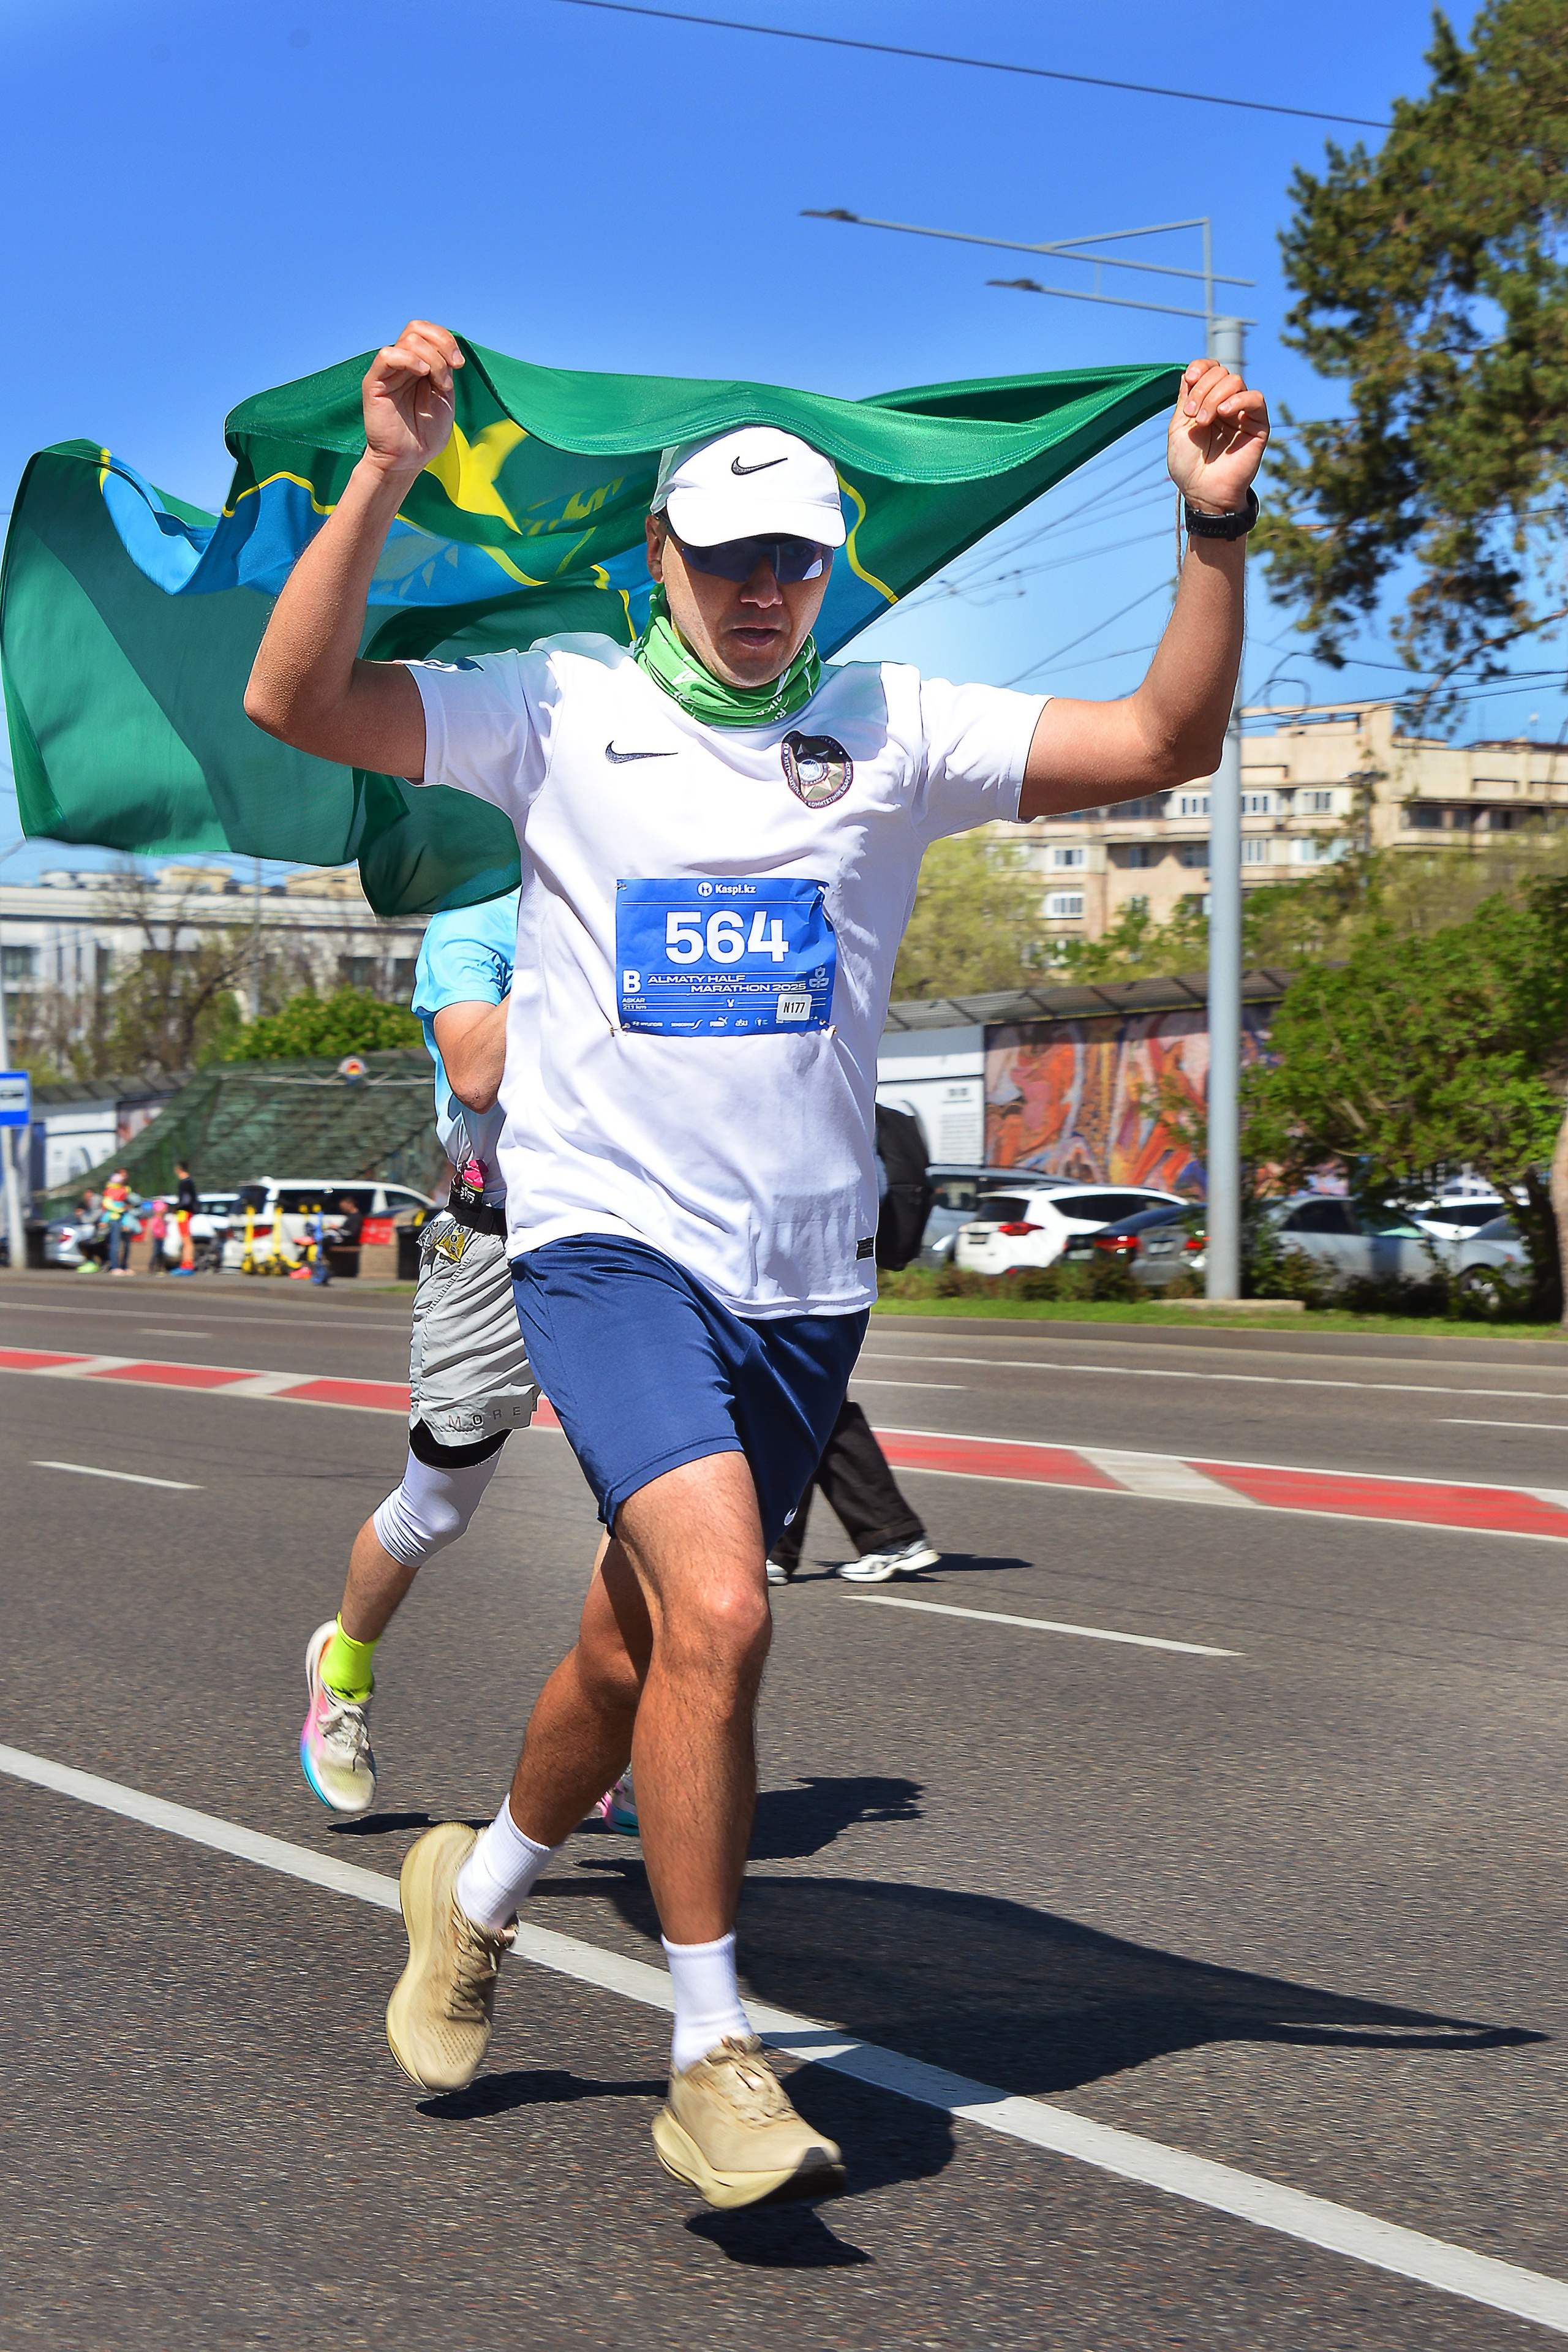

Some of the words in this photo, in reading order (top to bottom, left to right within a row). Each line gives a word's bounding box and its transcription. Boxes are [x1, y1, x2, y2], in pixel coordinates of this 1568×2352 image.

[715, 884, 756, 896] Kaspi.kz
[665, 910, 789, 965] 564
[622, 970, 641, 993] B
[690, 984, 771, 993] MARATHON
[772, 983, 807, 992] 2025
[783, 1001, 805, 1013] N177
[448, 1406, 521, 1428] MORE
